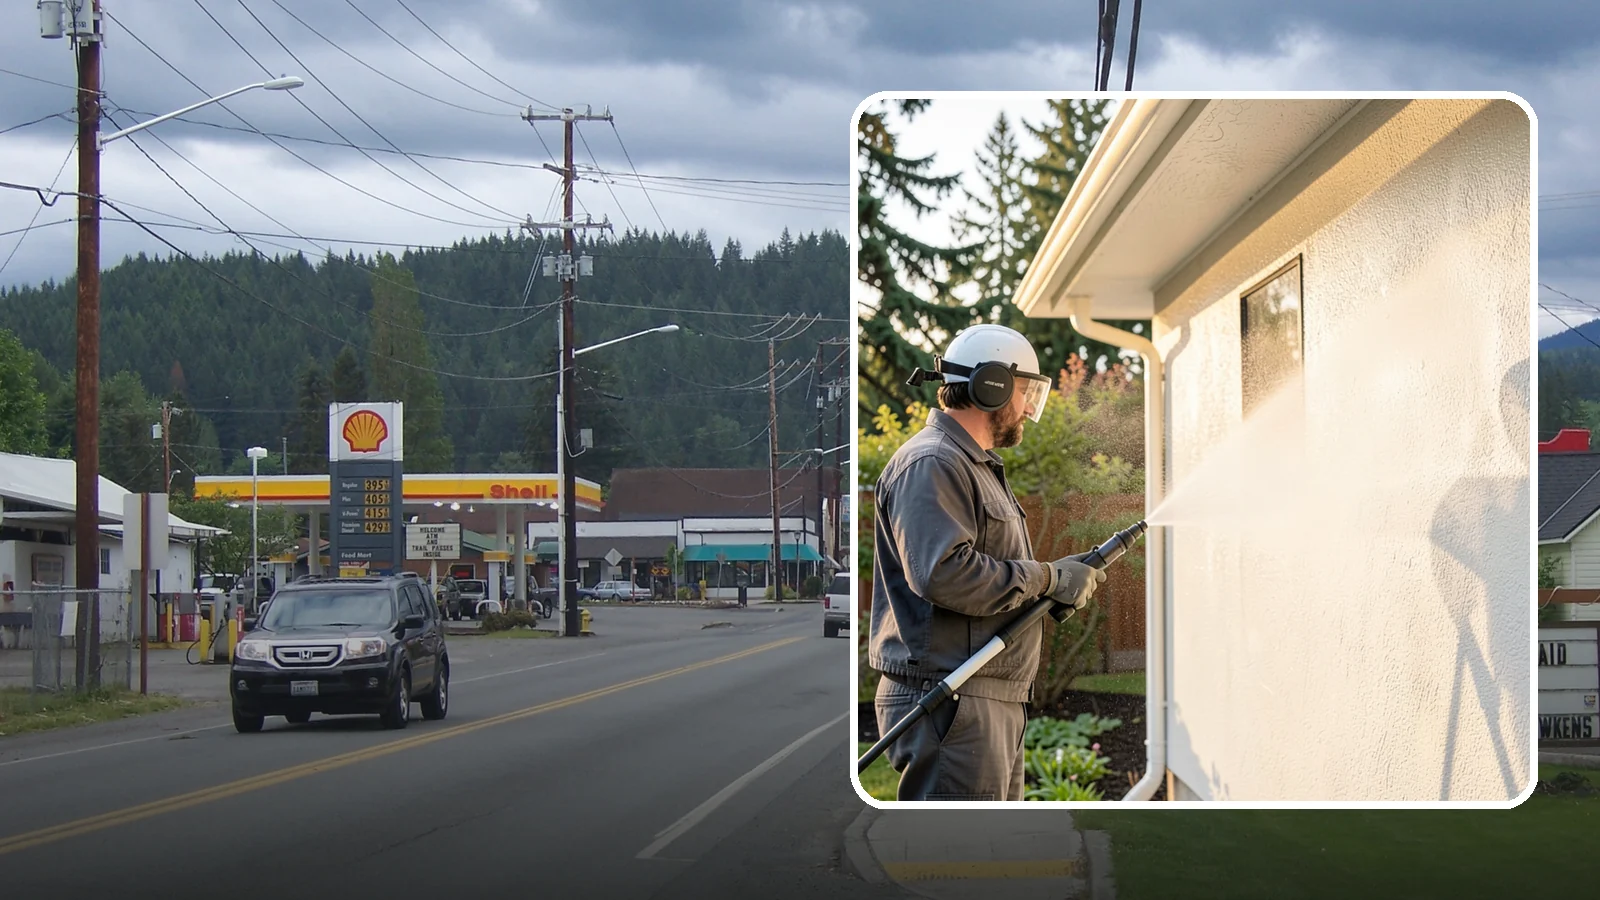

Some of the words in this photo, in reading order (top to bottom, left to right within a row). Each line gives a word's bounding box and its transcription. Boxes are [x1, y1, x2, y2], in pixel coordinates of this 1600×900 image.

[366, 480, 383, 490] 395
[490, 484, 547, 499] Shell
[366, 494, 383, 504] 405
[366, 508, 383, 518] 415
[366, 522, 383, 532] 429
